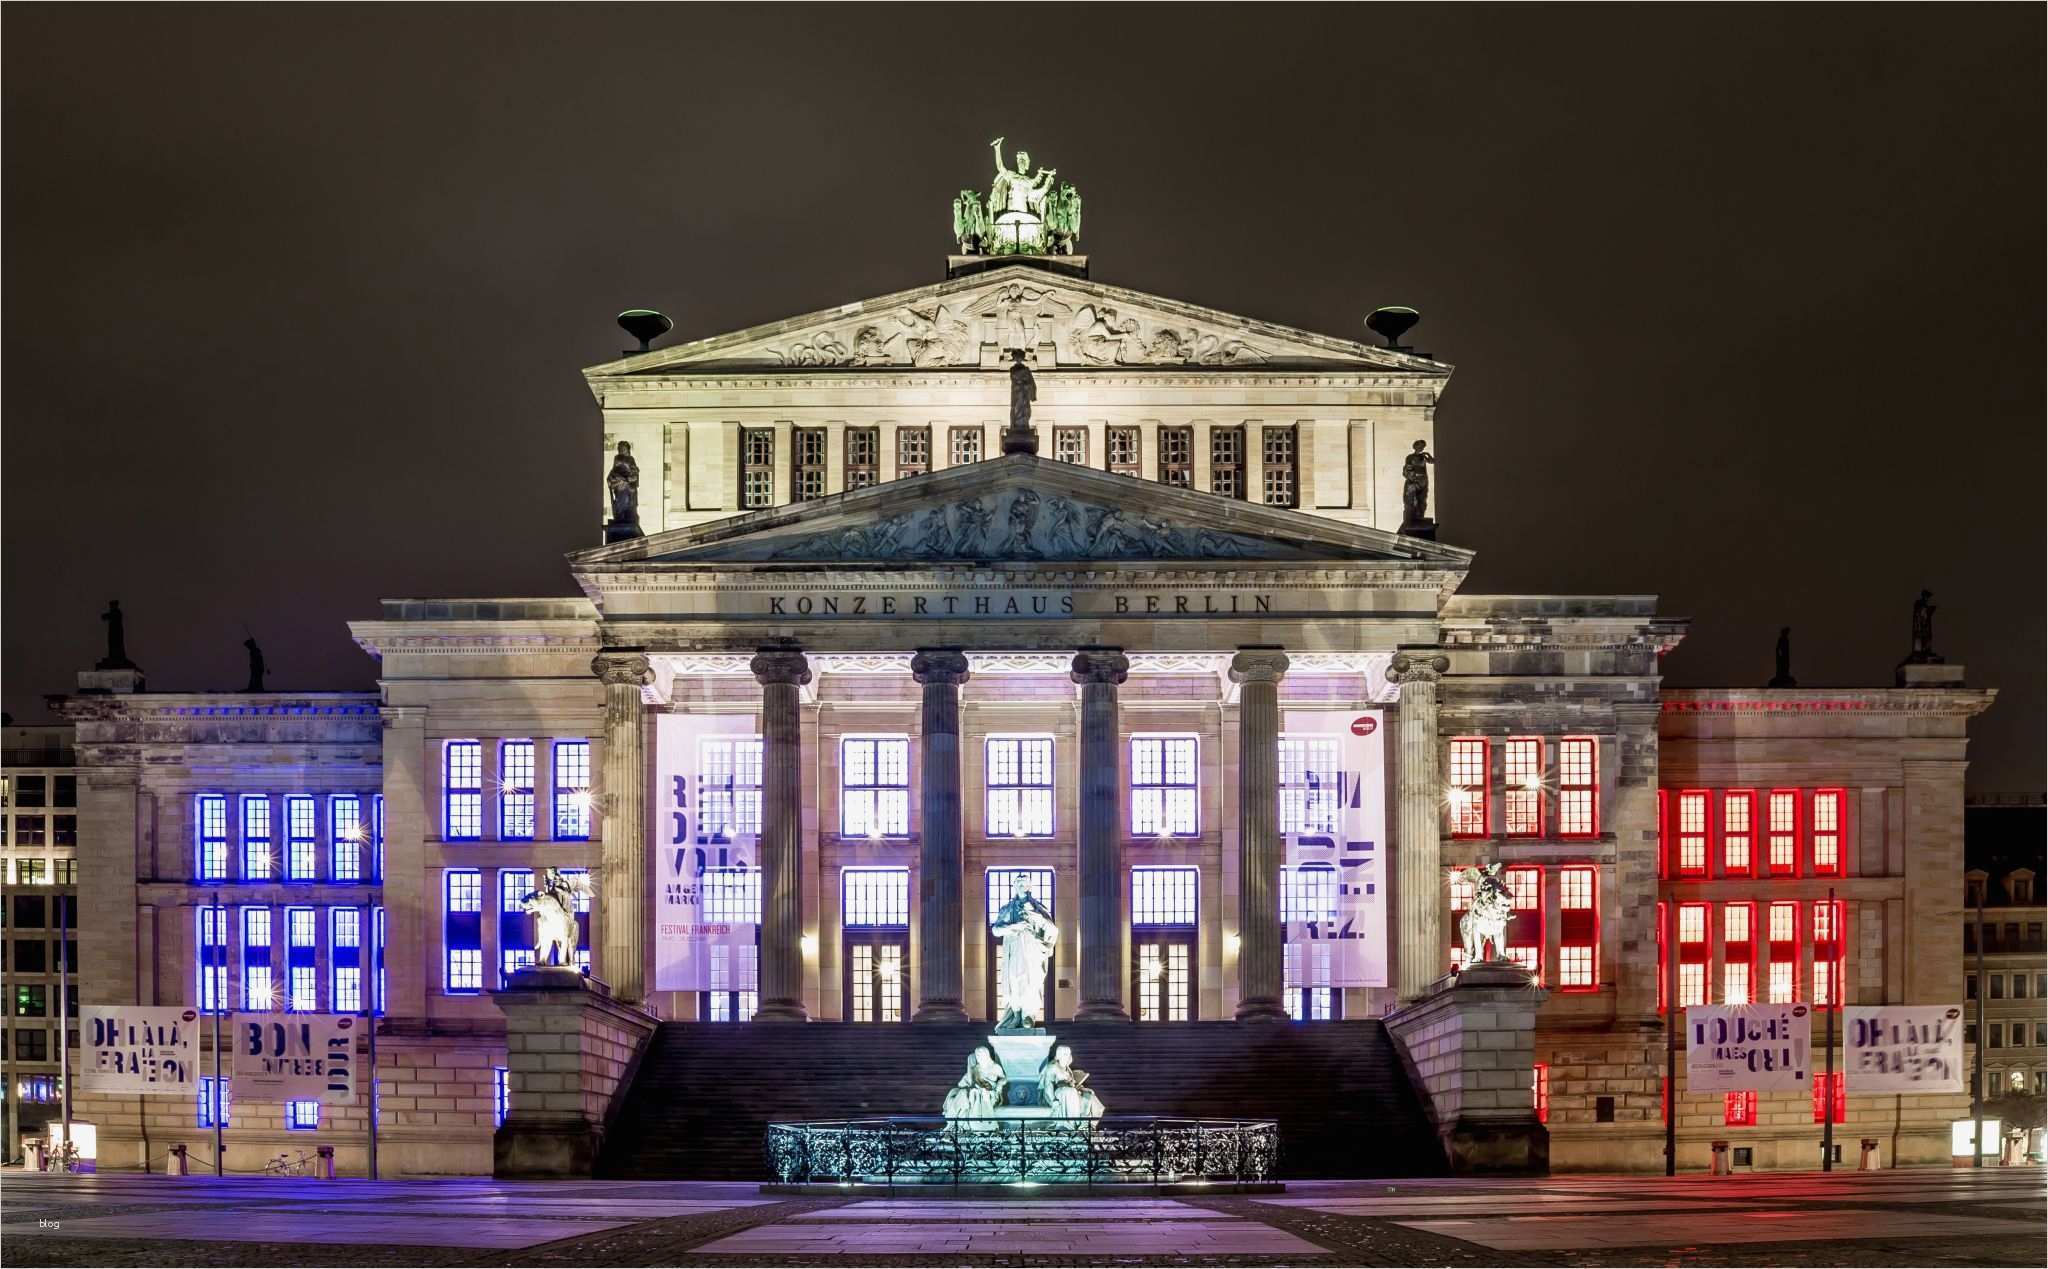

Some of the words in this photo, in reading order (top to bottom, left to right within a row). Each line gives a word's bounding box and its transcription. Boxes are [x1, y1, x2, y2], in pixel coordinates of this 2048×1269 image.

[770, 596, 1073, 614] KONZERTHAUS
[1114, 595, 1271, 614] BERLIN
[660, 924, 689, 935] FESTIVAL
[691, 924, 730, 935] FRANKREICH
[86, 1018, 126, 1047] OH
[241, 1022, 311, 1057] BON
